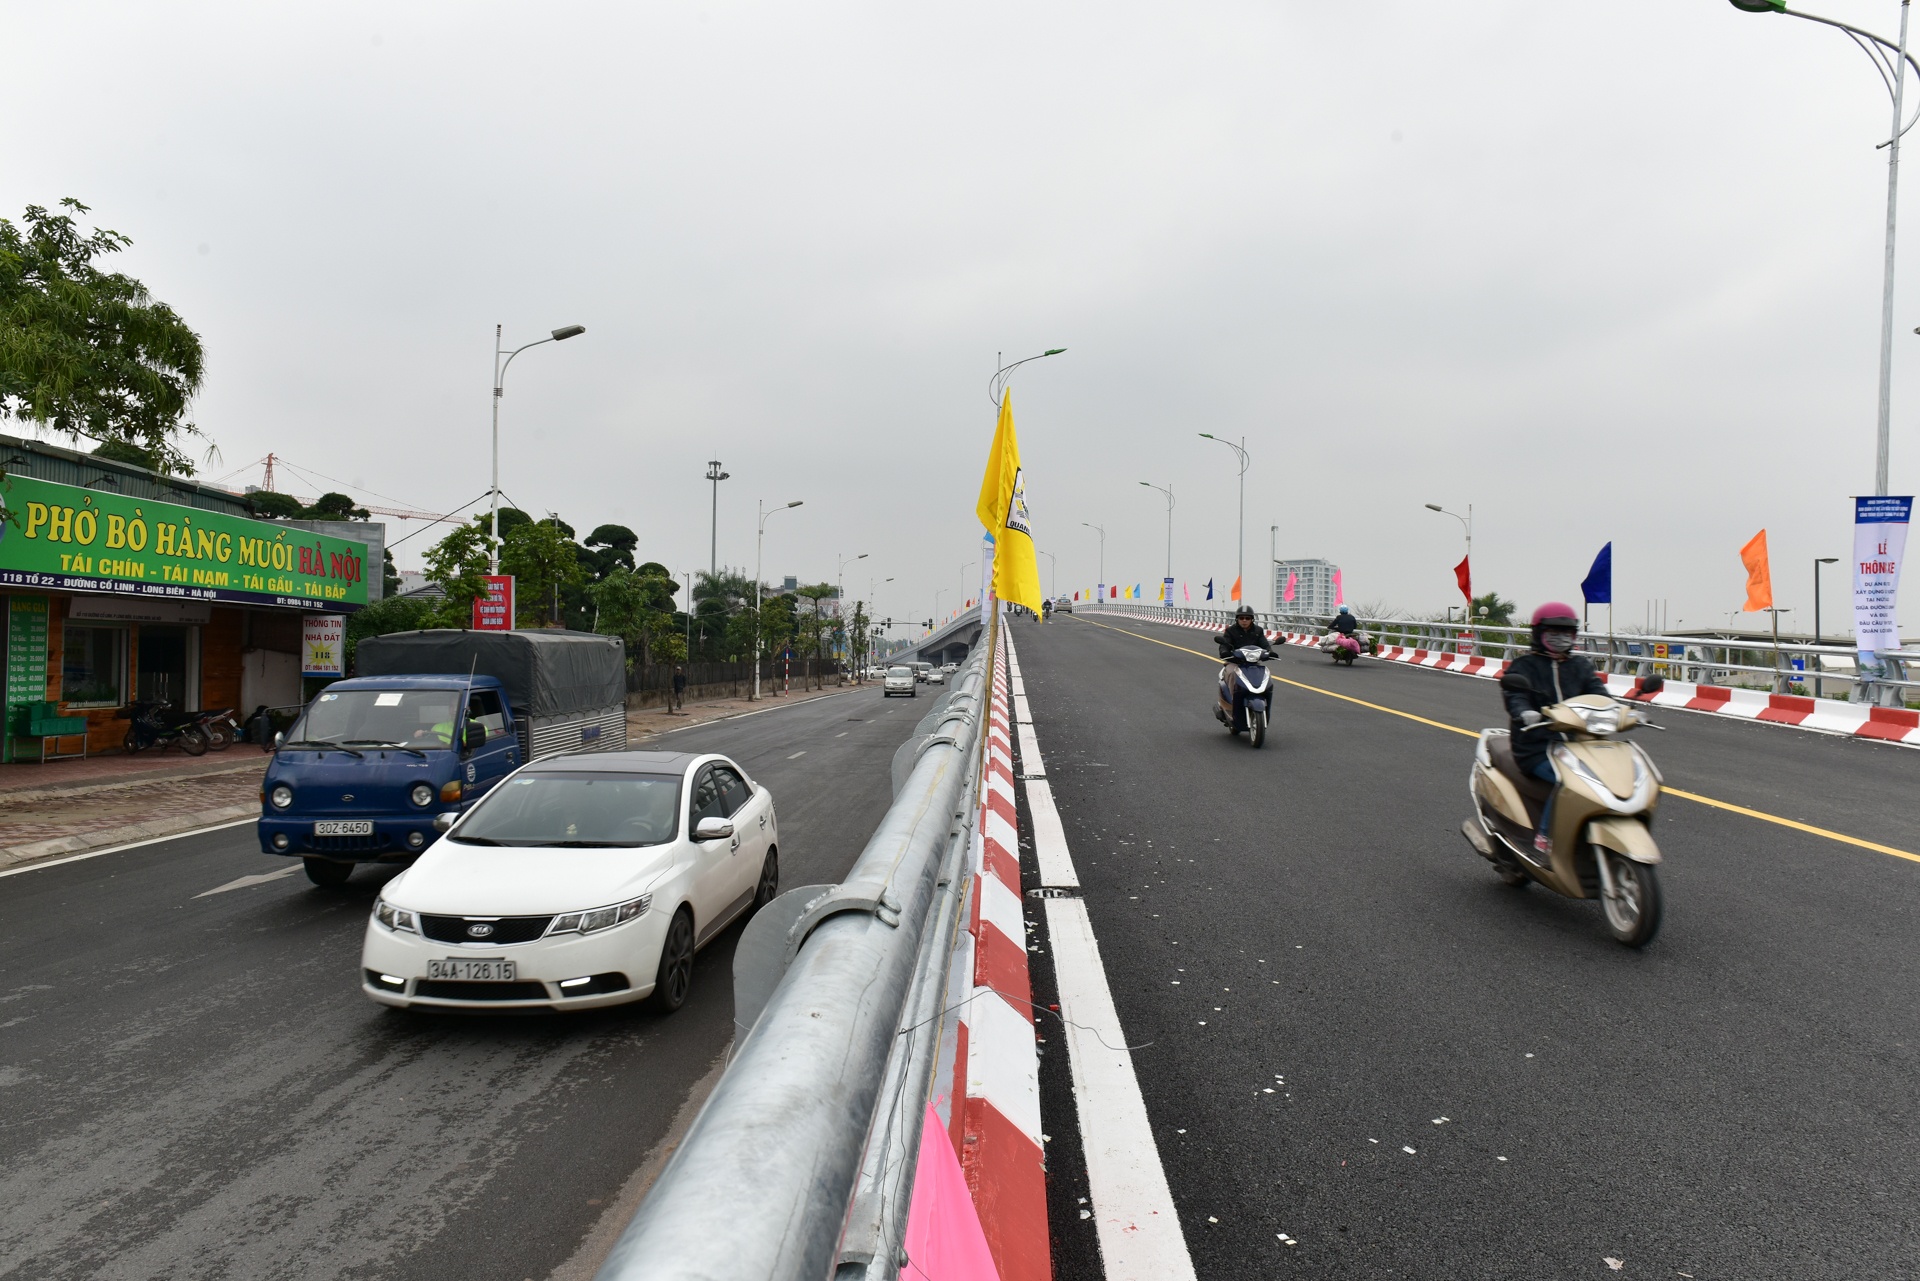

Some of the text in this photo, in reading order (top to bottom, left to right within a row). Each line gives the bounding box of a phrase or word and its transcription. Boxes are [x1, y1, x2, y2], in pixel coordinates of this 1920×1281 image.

[24, 495, 361, 587] PHỞ BÒ HÀNG MUỐI HÀ NỘI
[60, 553, 92, 572] TÁI
[99, 558, 144, 578] CHÍN
[163, 564, 188, 582] TÁI
[193, 569, 228, 588] NẠM
[243, 573, 263, 589] TÁI
[268, 575, 293, 593] GẦU
[305, 581, 322, 596] TÁI
[325, 583, 346, 599] BẮP
[3, 573, 22, 582] 118
[25, 573, 39, 584] TỔ
[41, 577, 54, 585] 22
[64, 578, 97, 589] ĐƯỜNG
[100, 579, 112, 590] CỔ
[114, 583, 134, 591] LINH
[143, 585, 164, 594] LONG
[166, 586, 184, 595] BIÊN
[191, 588, 202, 597] HÀ
[203, 590, 216, 599] NỘI
[305, 618, 328, 628] THÔNG
[324, 632, 340, 641] ĐẤT
[319, 822, 369, 834] 30Z-6450
[471, 926, 490, 934] KIA
[430, 962, 513, 980] 34A-126.15
